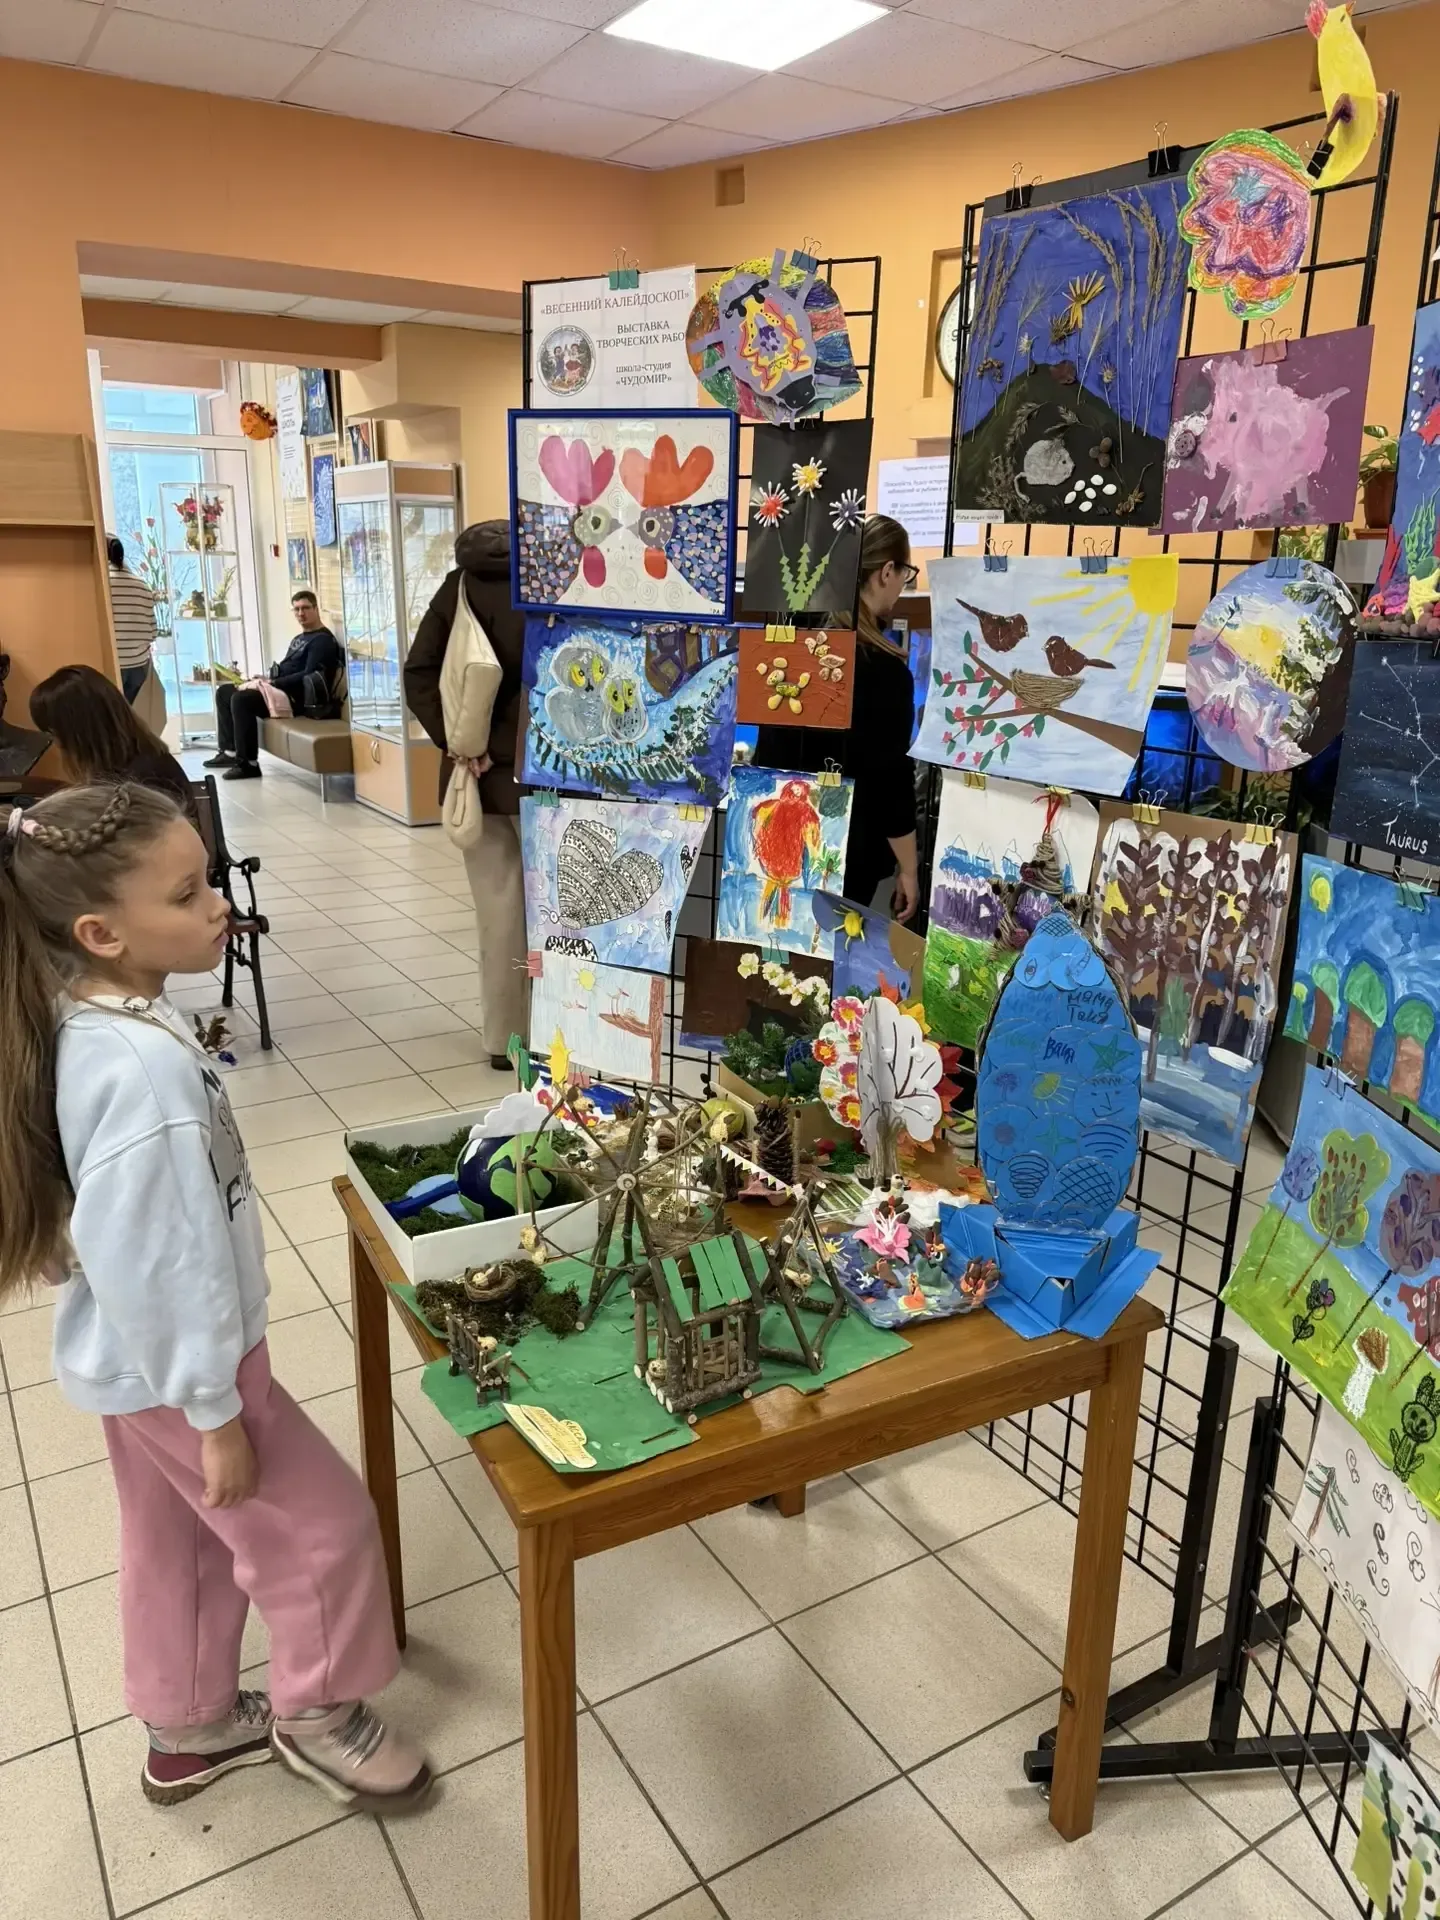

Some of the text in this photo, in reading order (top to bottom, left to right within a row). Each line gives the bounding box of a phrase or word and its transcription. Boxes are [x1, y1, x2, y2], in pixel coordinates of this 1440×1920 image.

[541, 289, 689, 315] «ВЕСЕННИЙ КАЛЕЙДОСКОП»
[617, 320, 670, 334] ВЫСТАВКА
[596, 331, 685, 349] ТВОРЧЕСКИХ РАБО
[616, 362, 672, 373] школа-студия
[616, 373, 672, 387] «ЧУДОМИР»
